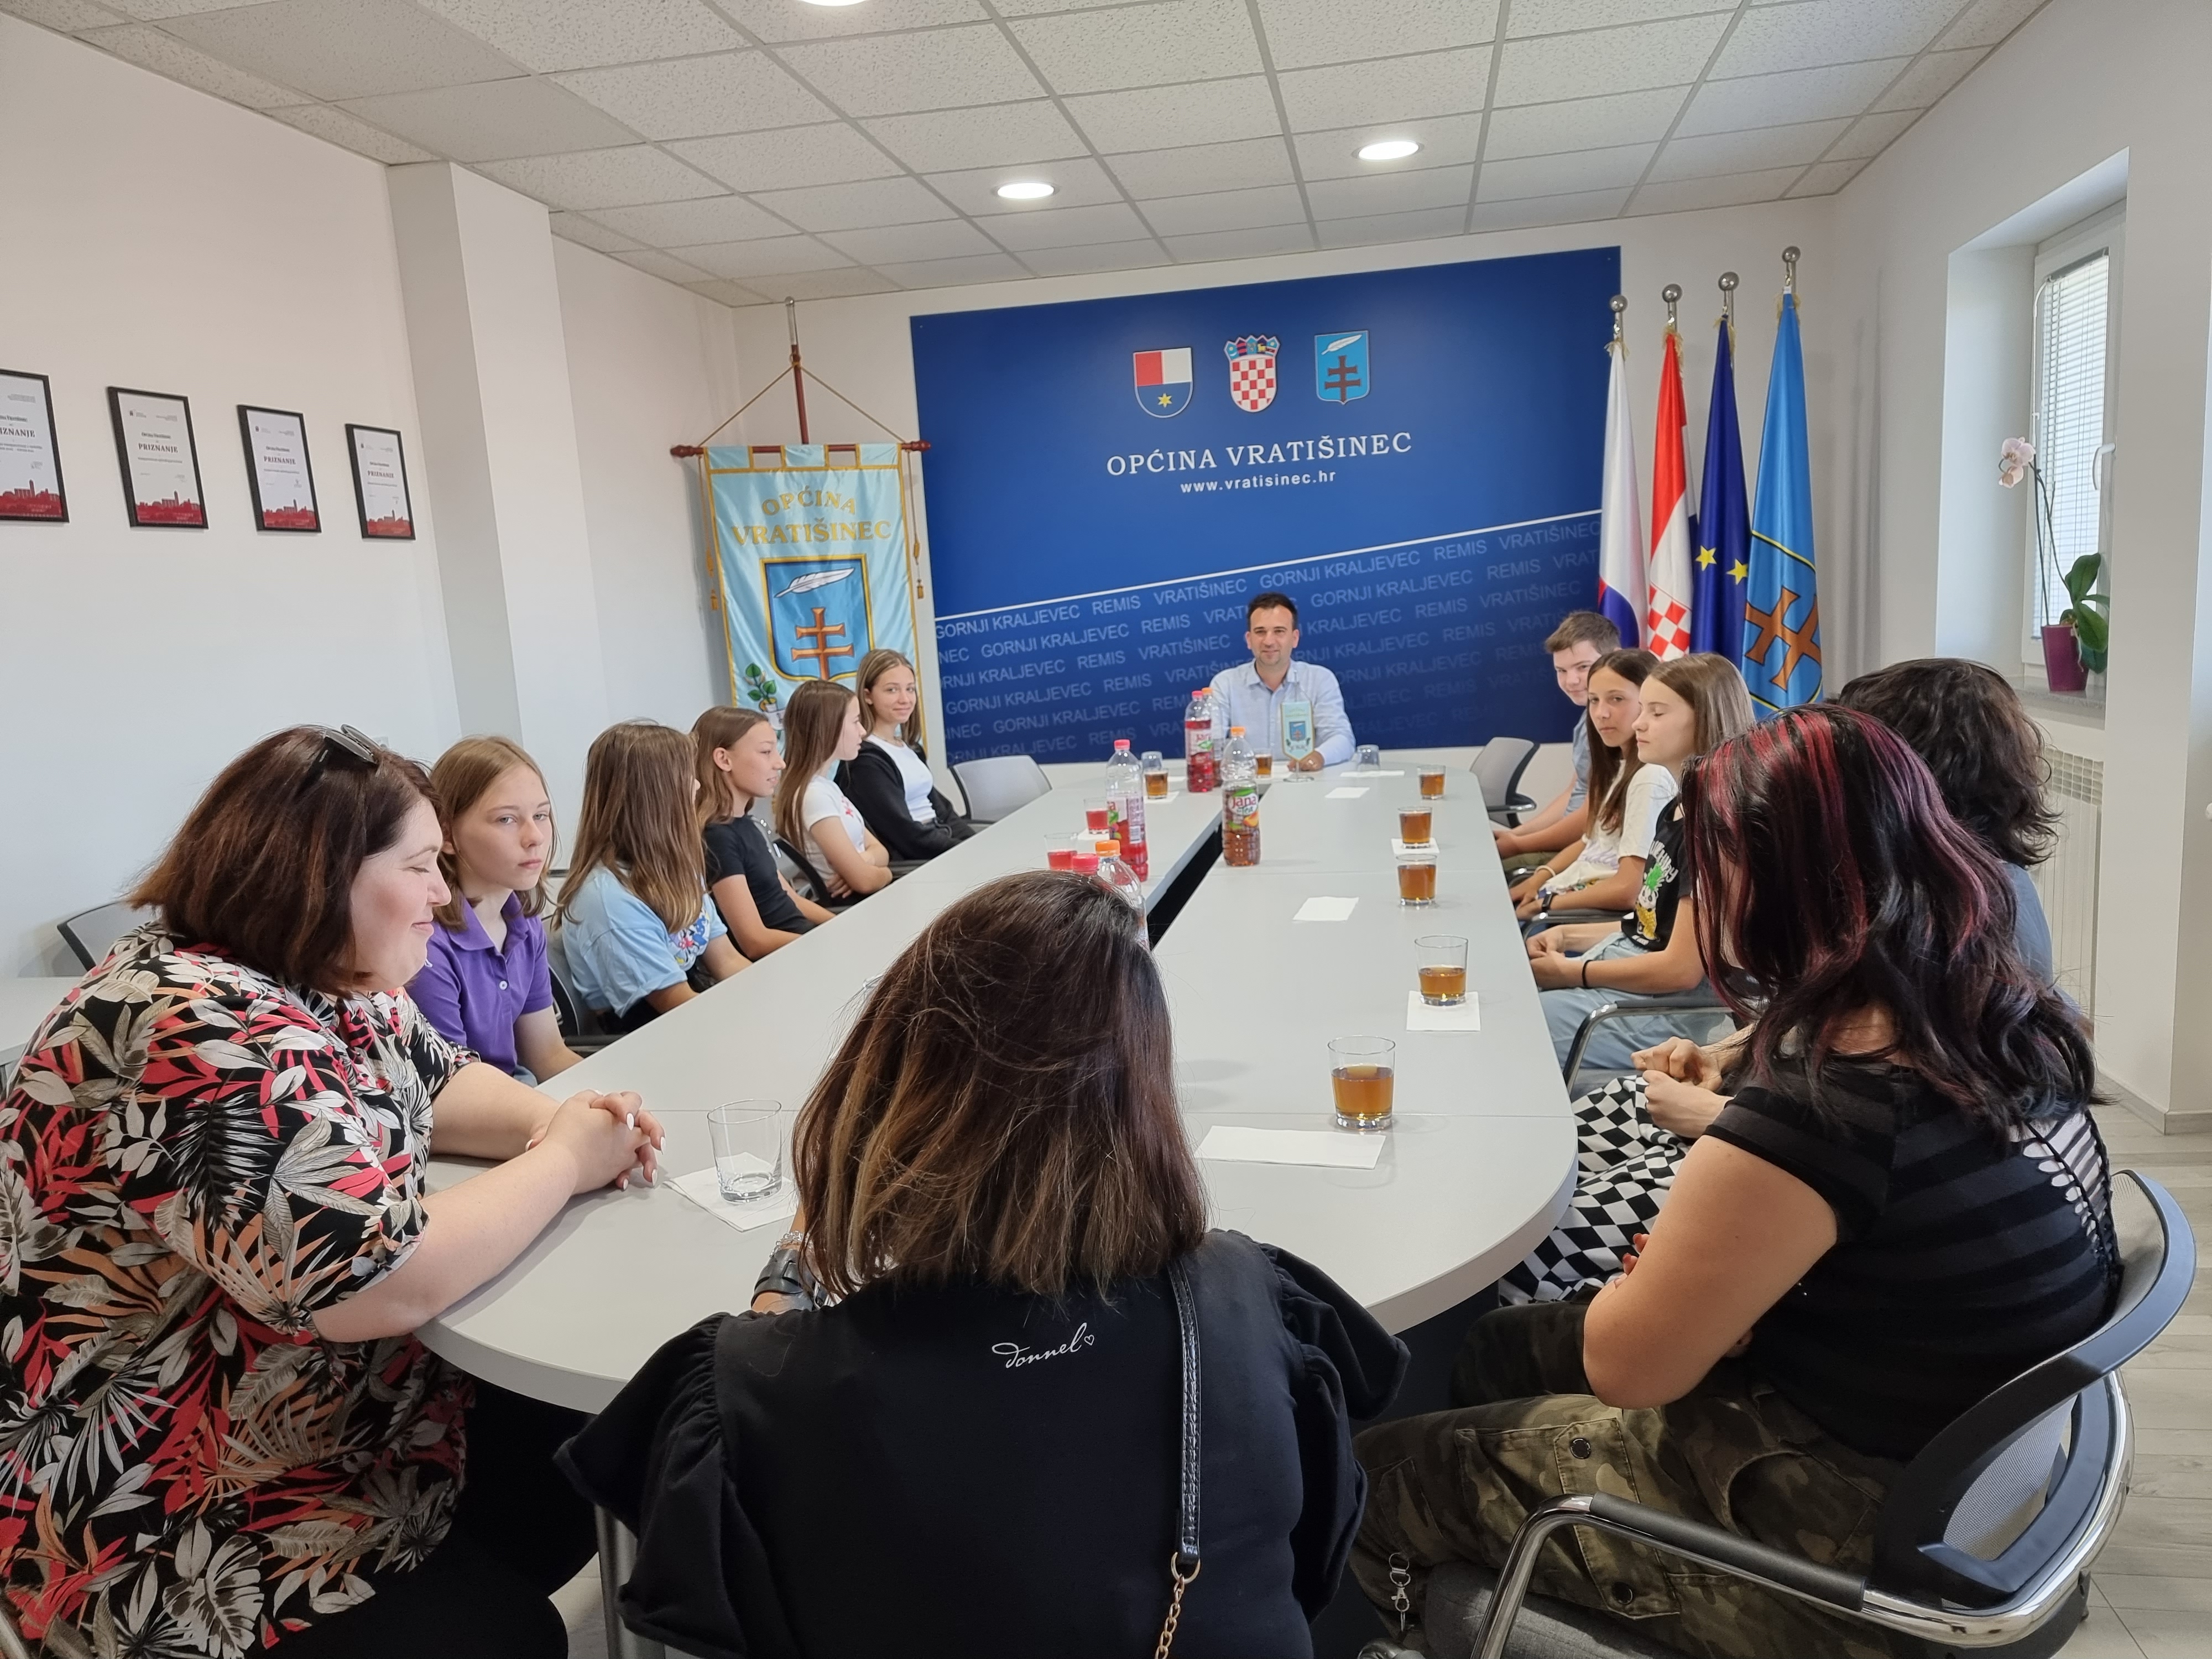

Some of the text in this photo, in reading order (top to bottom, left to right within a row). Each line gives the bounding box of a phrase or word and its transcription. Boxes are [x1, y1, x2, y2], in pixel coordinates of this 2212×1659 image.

[138, 443, 178, 453] PRIZNANJE
[264, 456, 296, 465] PRIZNANJE
[1107, 431, 1412, 476] OPĆINA VRATIŠINEC
[761, 485, 856, 517] OPĆINA
[1180, 470, 1336, 493] www.vratisinec.hr
[732, 517, 891, 546] VRATIŠINEC
[935, 618, 990, 639] GORNJI
[992, 604, 1081, 632] KRALJEVEC
[1092, 594, 1141, 616] REMIS
[1153, 578, 1248, 606] VRATIŠINEC
[1259, 566, 1320, 589] GORNJI
[1324, 550, 1421, 579] KRALJEVEC
[1433, 539, 1488, 561] REMIS
[980, 637, 1037, 658] GORNJI
[1040, 623, 1130, 649] KRALJEVEC
[1141, 613, 1191, 635] REMIS
[1310, 585, 1371, 608] GORNJI
[1376, 569, 1473, 599] KRALJEVEC
[1486, 558, 1542, 580] REMIS
[941, 671, 976, 690] RNJI
[978, 659, 1066, 685] KRALJEVEC
[1076, 650, 1126, 670] REMIS
[1138, 634, 1232, 661] VRATIŠINEC
[1306, 608, 1402, 636] KRALJEVEC
[1415, 597, 1468, 619] REMIS
[1479, 580, 1582, 609] VRATIŠINEC
[946, 695, 1001, 715] GORNJI
[1004, 681, 1093, 707] KRALJEVEC
[1103, 672, 1152, 693] REMIS
[1334, 632, 1430, 659] KRALJEVEC
[1442, 622, 1496, 643] REMIS
[993, 715, 1049, 734] GORNJI
[1052, 700, 1141, 726] KRALJEVEC
[1385, 651, 1483, 678] KRALJEVEC
